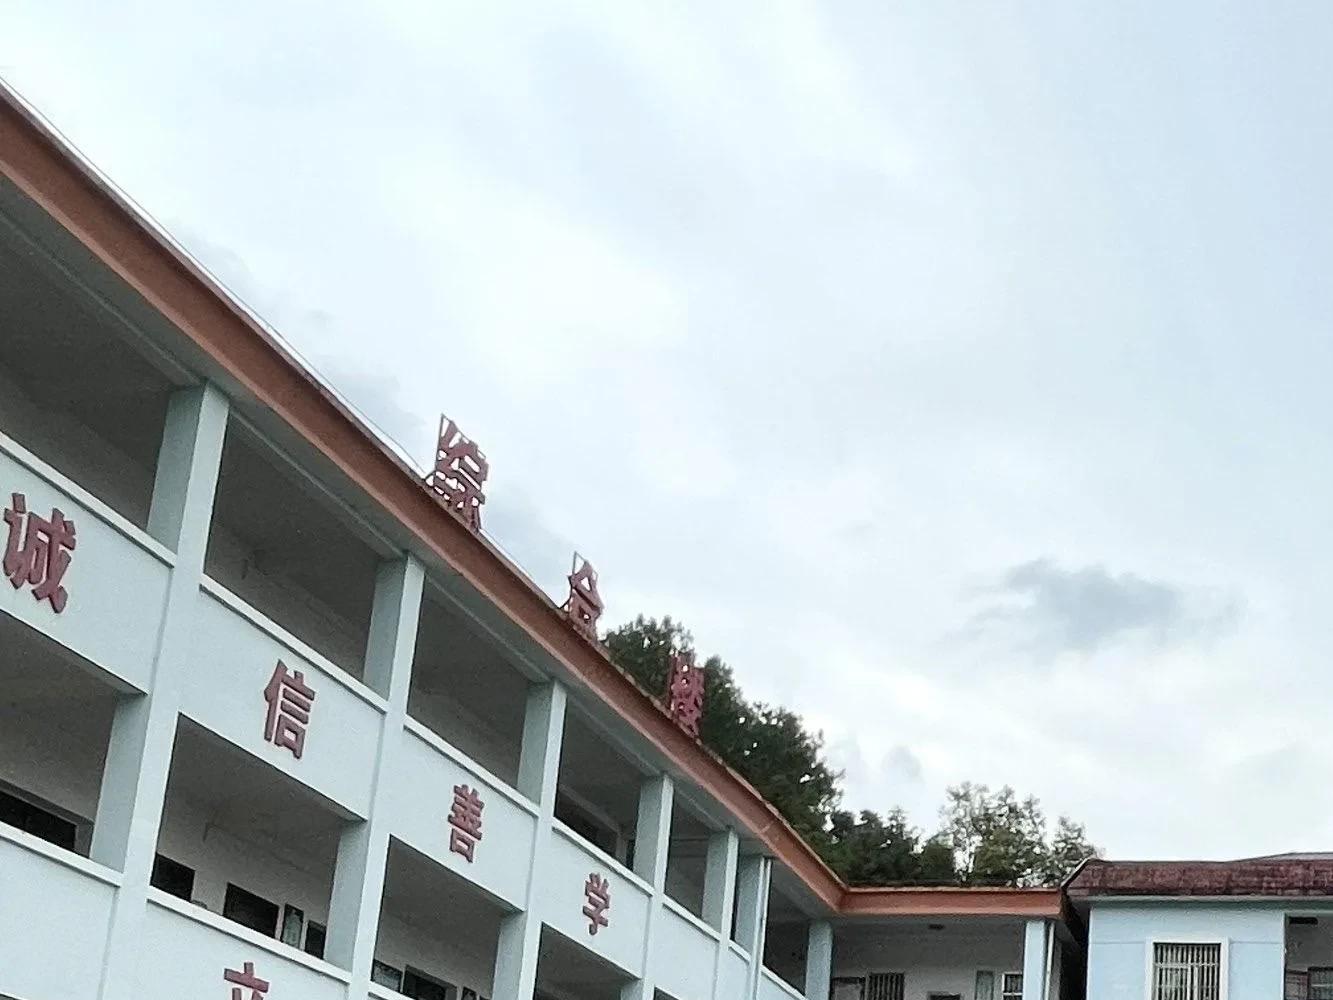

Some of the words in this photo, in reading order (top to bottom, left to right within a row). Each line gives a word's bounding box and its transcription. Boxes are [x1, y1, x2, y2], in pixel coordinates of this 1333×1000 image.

[4, 493, 76, 614] 诚
[264, 659, 315, 760] 信
[447, 783, 483, 863] 善
[583, 872, 611, 935] 学
